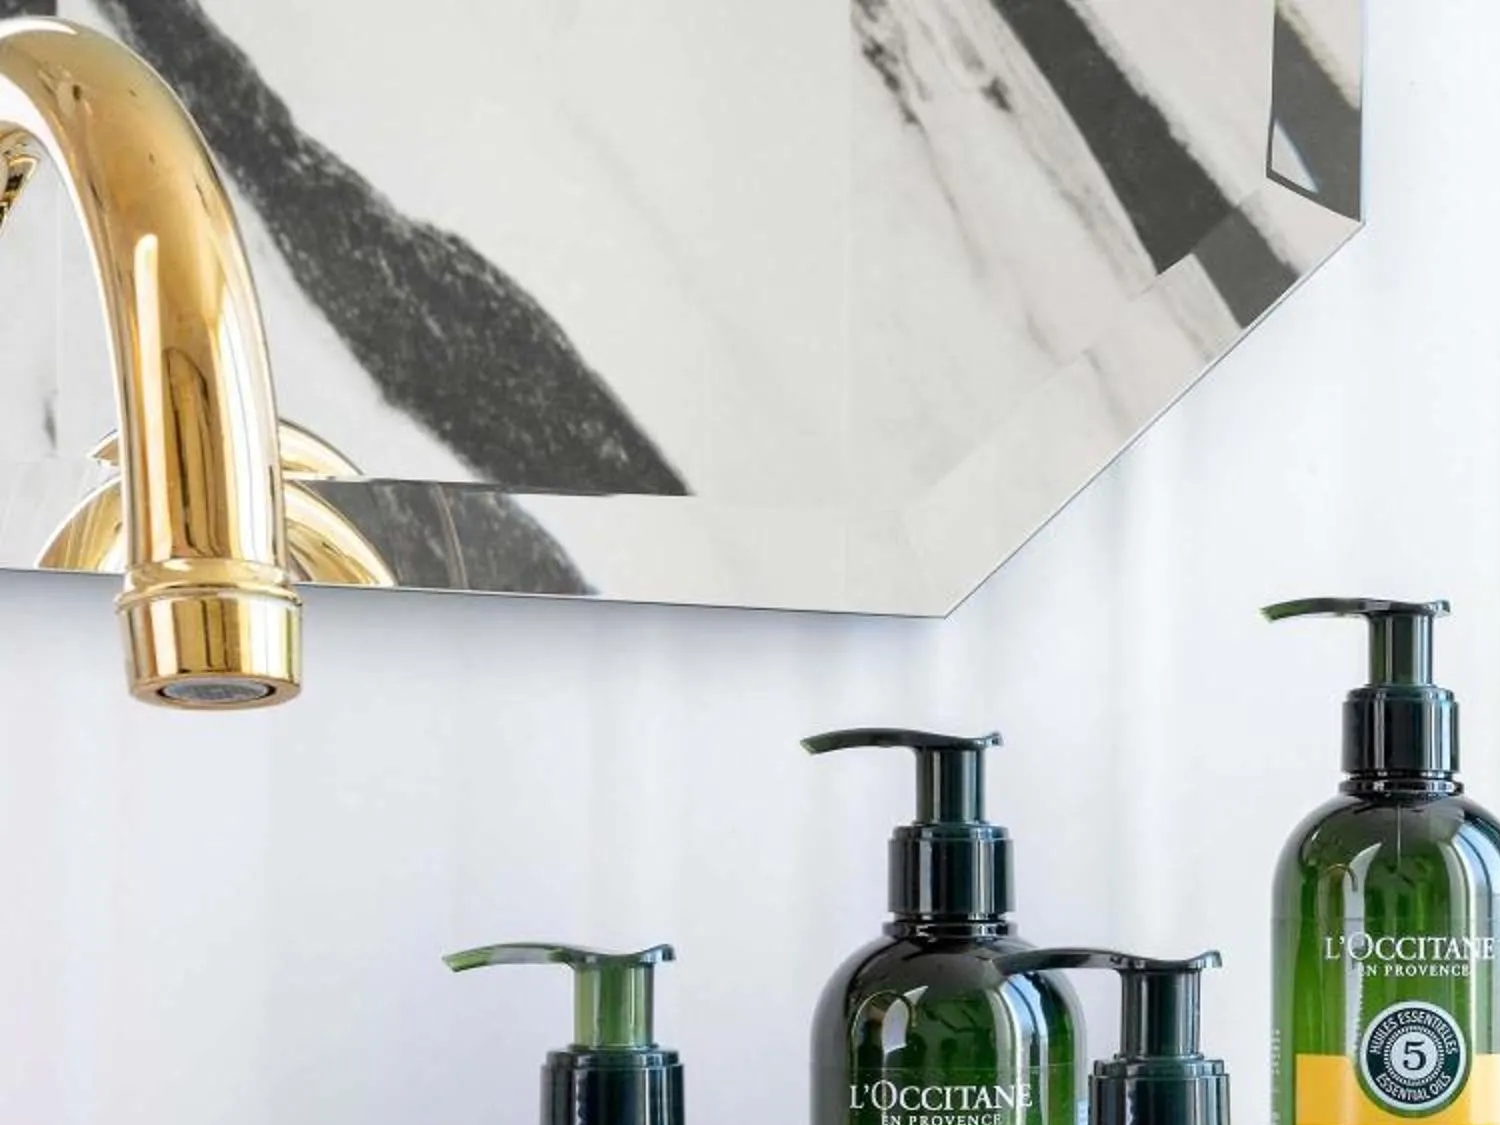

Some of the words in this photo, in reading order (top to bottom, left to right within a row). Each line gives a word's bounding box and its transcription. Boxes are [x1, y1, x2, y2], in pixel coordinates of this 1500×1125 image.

[1325, 931, 1495, 961] L'OCCITANE
[1384, 964, 1470, 978] PROVENCE
[1369, 1018, 1398, 1054] HUILES
[1398, 1011, 1458, 1055] ESSENTIELLES
[1403, 1041, 1427, 1071] 5
[850, 1080, 1032, 1111] L'OCCITANE
[1376, 1073, 1429, 1101] ESSENTIAL
[1430, 1072, 1453, 1095] OILS
